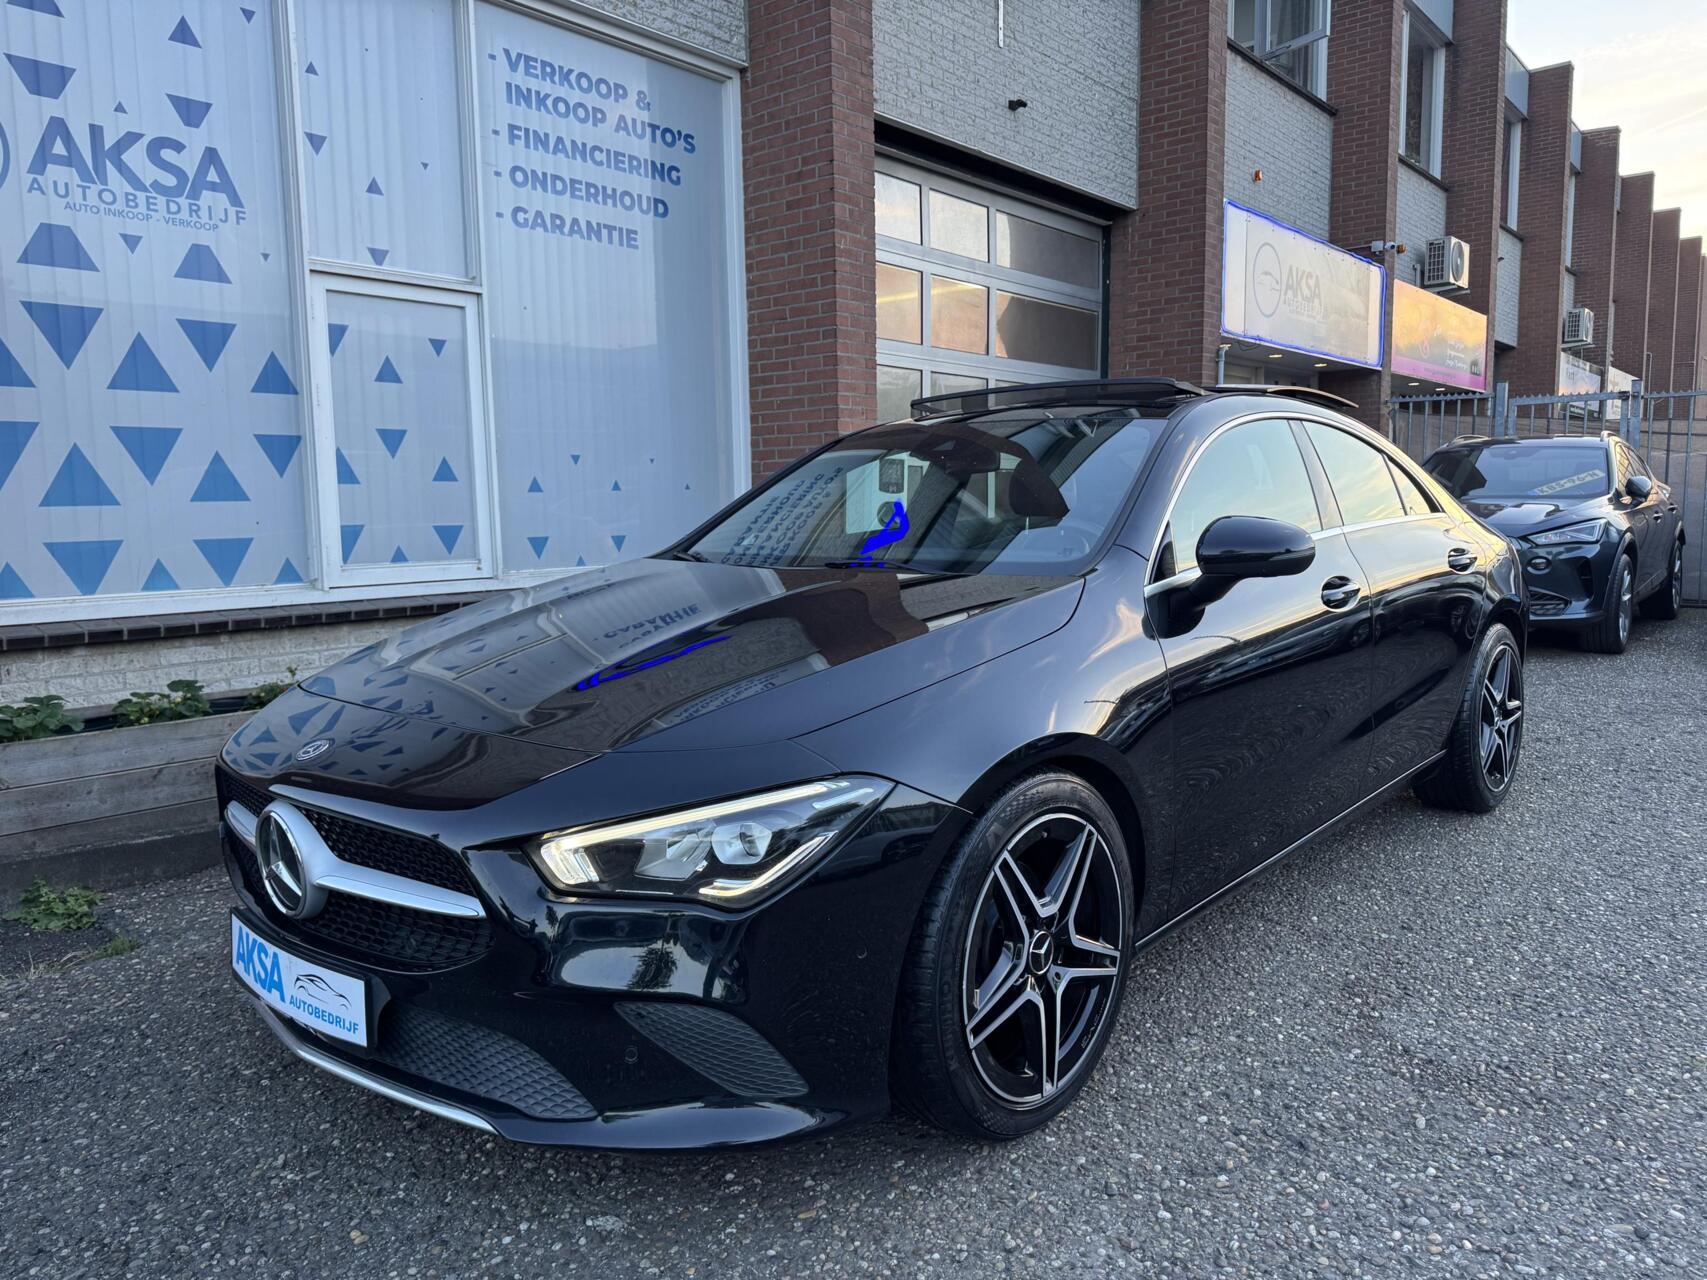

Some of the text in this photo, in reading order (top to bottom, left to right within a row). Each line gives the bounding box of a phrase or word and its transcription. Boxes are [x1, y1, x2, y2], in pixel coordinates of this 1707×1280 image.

[502, 47, 628, 103] VERKOOP
[635, 90, 651, 112] &
[505, 81, 696, 154] INKOOP AUTO'S
[26, 115, 245, 209] AKSA
[507, 123, 681, 186] FINANCIERING
[26, 176, 247, 226] AUTOBEDRIJF
[64, 201, 100, 215] AUTO
[103, 207, 152, 223] INKOOP
[163, 215, 219, 233] VERKOOP
[509, 165, 669, 219] ONDERHOUD
[511, 206, 640, 250] GARANTIE
[1283, 264, 1322, 306] AKSA
[236, 925, 286, 1003] AKSA
[289, 994, 359, 1035] AUTOBEDRIJF
